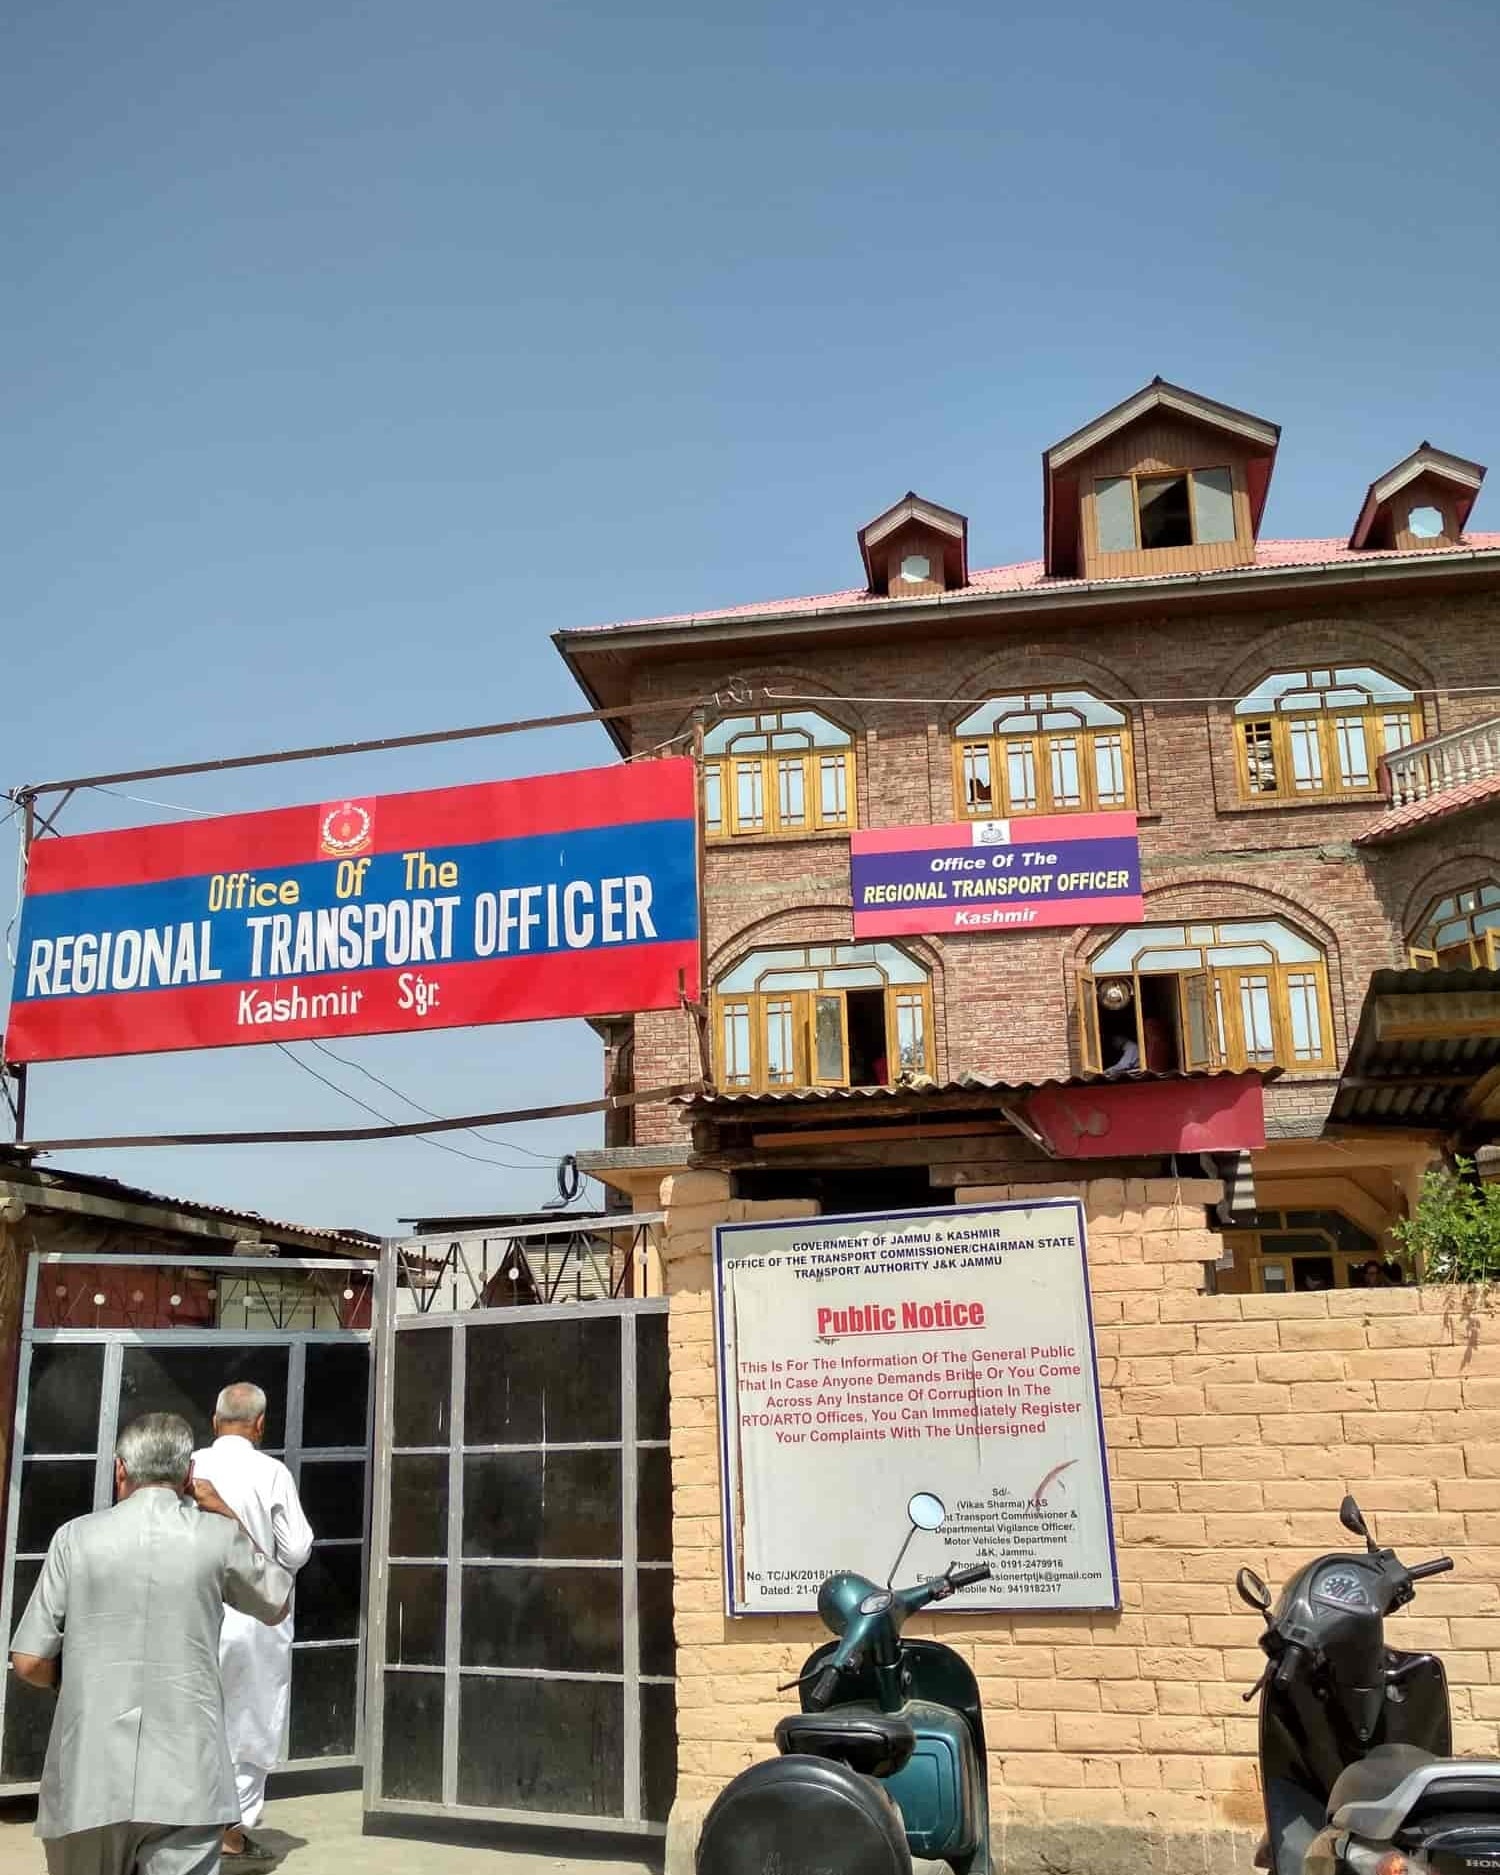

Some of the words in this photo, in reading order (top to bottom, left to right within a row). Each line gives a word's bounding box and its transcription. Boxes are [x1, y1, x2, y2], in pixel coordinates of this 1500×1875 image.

[930, 857, 986, 872] Office
[992, 854, 1013, 868] Of
[1022, 852, 1057, 866] The
[208, 872, 299, 912] Office
[336, 857, 372, 898] Of
[402, 851, 458, 892] The
[864, 881, 947, 904] REGIONAL
[952, 875, 1052, 898] TRANSPORT
[1057, 870, 1129, 891] OFFICER
[954, 908, 1038, 926] Kashmir
[27, 918, 222, 997] REGIONAL
[247, 896, 461, 977] TRANSPORT
[475, 874, 657, 956] OFFICER
[238, 986, 362, 1025] Kashmir
[792, 1238, 869, 1252] GOVERNMENT
[872, 1236, 887, 1247] OF
[890, 1233, 931, 1245] JAMMU
[935, 1233, 943, 1242] &
[947, 1228, 1001, 1241] KASHMIR
[727, 1259, 765, 1270] OFFICE
[768, 1257, 783, 1267] OF
[786, 1256, 808, 1266] THE
[811, 1249, 877, 1265] TRANSPORT
[880, 1240, 1034, 1259] COMMISSIONER/CHAIRMAN
[1038, 1237, 1076, 1249] STATE
[794, 1265, 860, 1279] TRANSPORT
[864, 1261, 928, 1274] AUTHORITY
[933, 1259, 958, 1270] J&K
[960, 1256, 1002, 1268] JAMMU
[817, 1305, 896, 1334] Public
[901, 1300, 985, 1329] Notice
[740, 1361, 768, 1373] This
[772, 1361, 783, 1372] Is
[787, 1360, 809, 1371] For
[813, 1358, 837, 1370] The
[841, 1354, 918, 1369] Information
[922, 1352, 939, 1364] Of
[942, 1351, 967, 1363] The
[972, 1349, 1026, 1361] General
[1031, 1346, 1075, 1358] Public
[738, 1379, 766, 1391] That
[770, 1379, 782, 1390] In
[786, 1377, 818, 1389] Case
[822, 1375, 873, 1389] Anyone
[877, 1370, 941, 1385] Demands
[945, 1368, 982, 1381] Bribe
[986, 1367, 1003, 1379] Or
[1008, 1366, 1034, 1378] You
[1039, 1364, 1081, 1377] Come
[766, 1396, 812, 1408] Across
[816, 1393, 842, 1407] Any
[847, 1390, 904, 1404] Instance
[907, 1388, 924, 1401] Of
[927, 1386, 1004, 1402] Corruption
[1007, 1385, 1020, 1396] In
[1024, 1383, 1052, 1395] The
[742, 1412, 812, 1427] RTO/ARTO
[816, 1410, 868, 1424] Offices,
[871, 1409, 897, 1421] You
[901, 1407, 928, 1420] Can
[932, 1403, 1017, 1419] Immediately
[1021, 1401, 1082, 1417] Register
[775, 1431, 808, 1443] Your
[810, 1428, 886, 1443] Complaints
[890, 1426, 921, 1439] With
[926, 1425, 951, 1437] The
[955, 1420, 1046, 1437] Undersigned
[955, 1513, 999, 1522] Transport
[1001, 1511, 1068, 1520] Commissioner
[1071, 1511, 1078, 1519] &
[956, 1501, 985, 1510] (Vikas
[987, 1499, 1026, 1510] Sharma)
[1028, 1499, 1048, 1507] KAS
[944, 1536, 970, 1546] Motor
[973, 1536, 1011, 1545] Vehicles
[1014, 1535, 1067, 1545] Department
[998, 1523, 1039, 1534] Vigilance
[760, 1585, 794, 1595] Dated:
[1007, 1584, 1062, 1593] 9419182317
